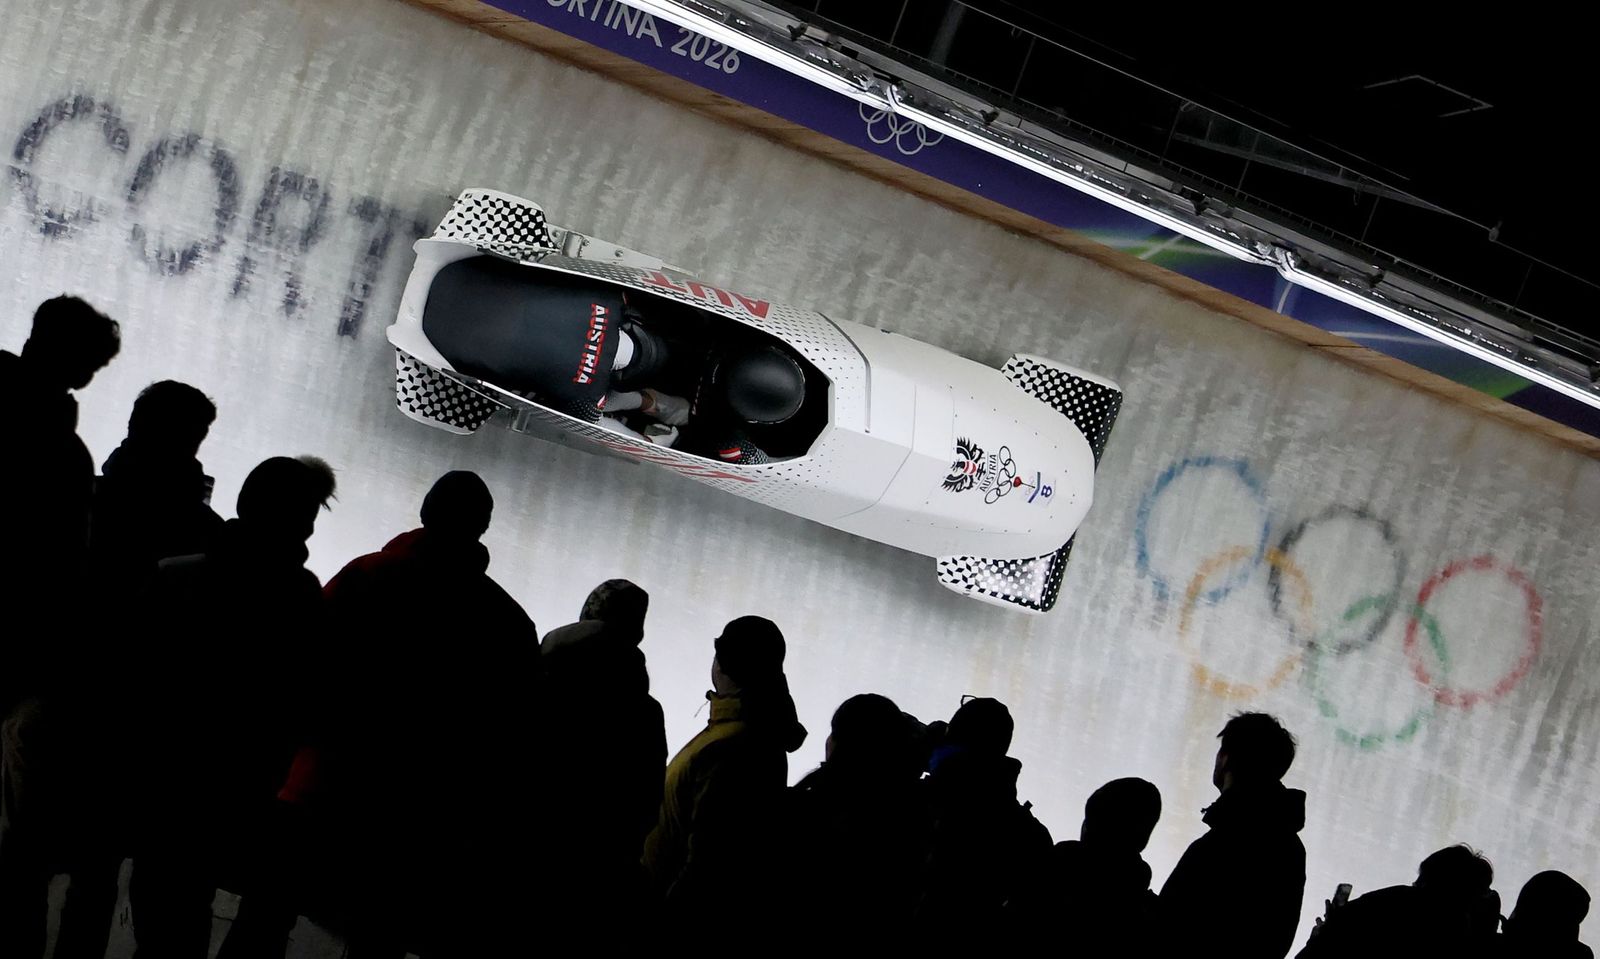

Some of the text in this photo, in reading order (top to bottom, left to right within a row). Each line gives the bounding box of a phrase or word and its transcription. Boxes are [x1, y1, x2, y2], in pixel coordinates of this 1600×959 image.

[547, 0, 741, 74] RTINA 2026
[641, 271, 770, 319] AUT
[572, 303, 611, 385] AUSTRIA
[979, 453, 998, 492] AUSTRIA
